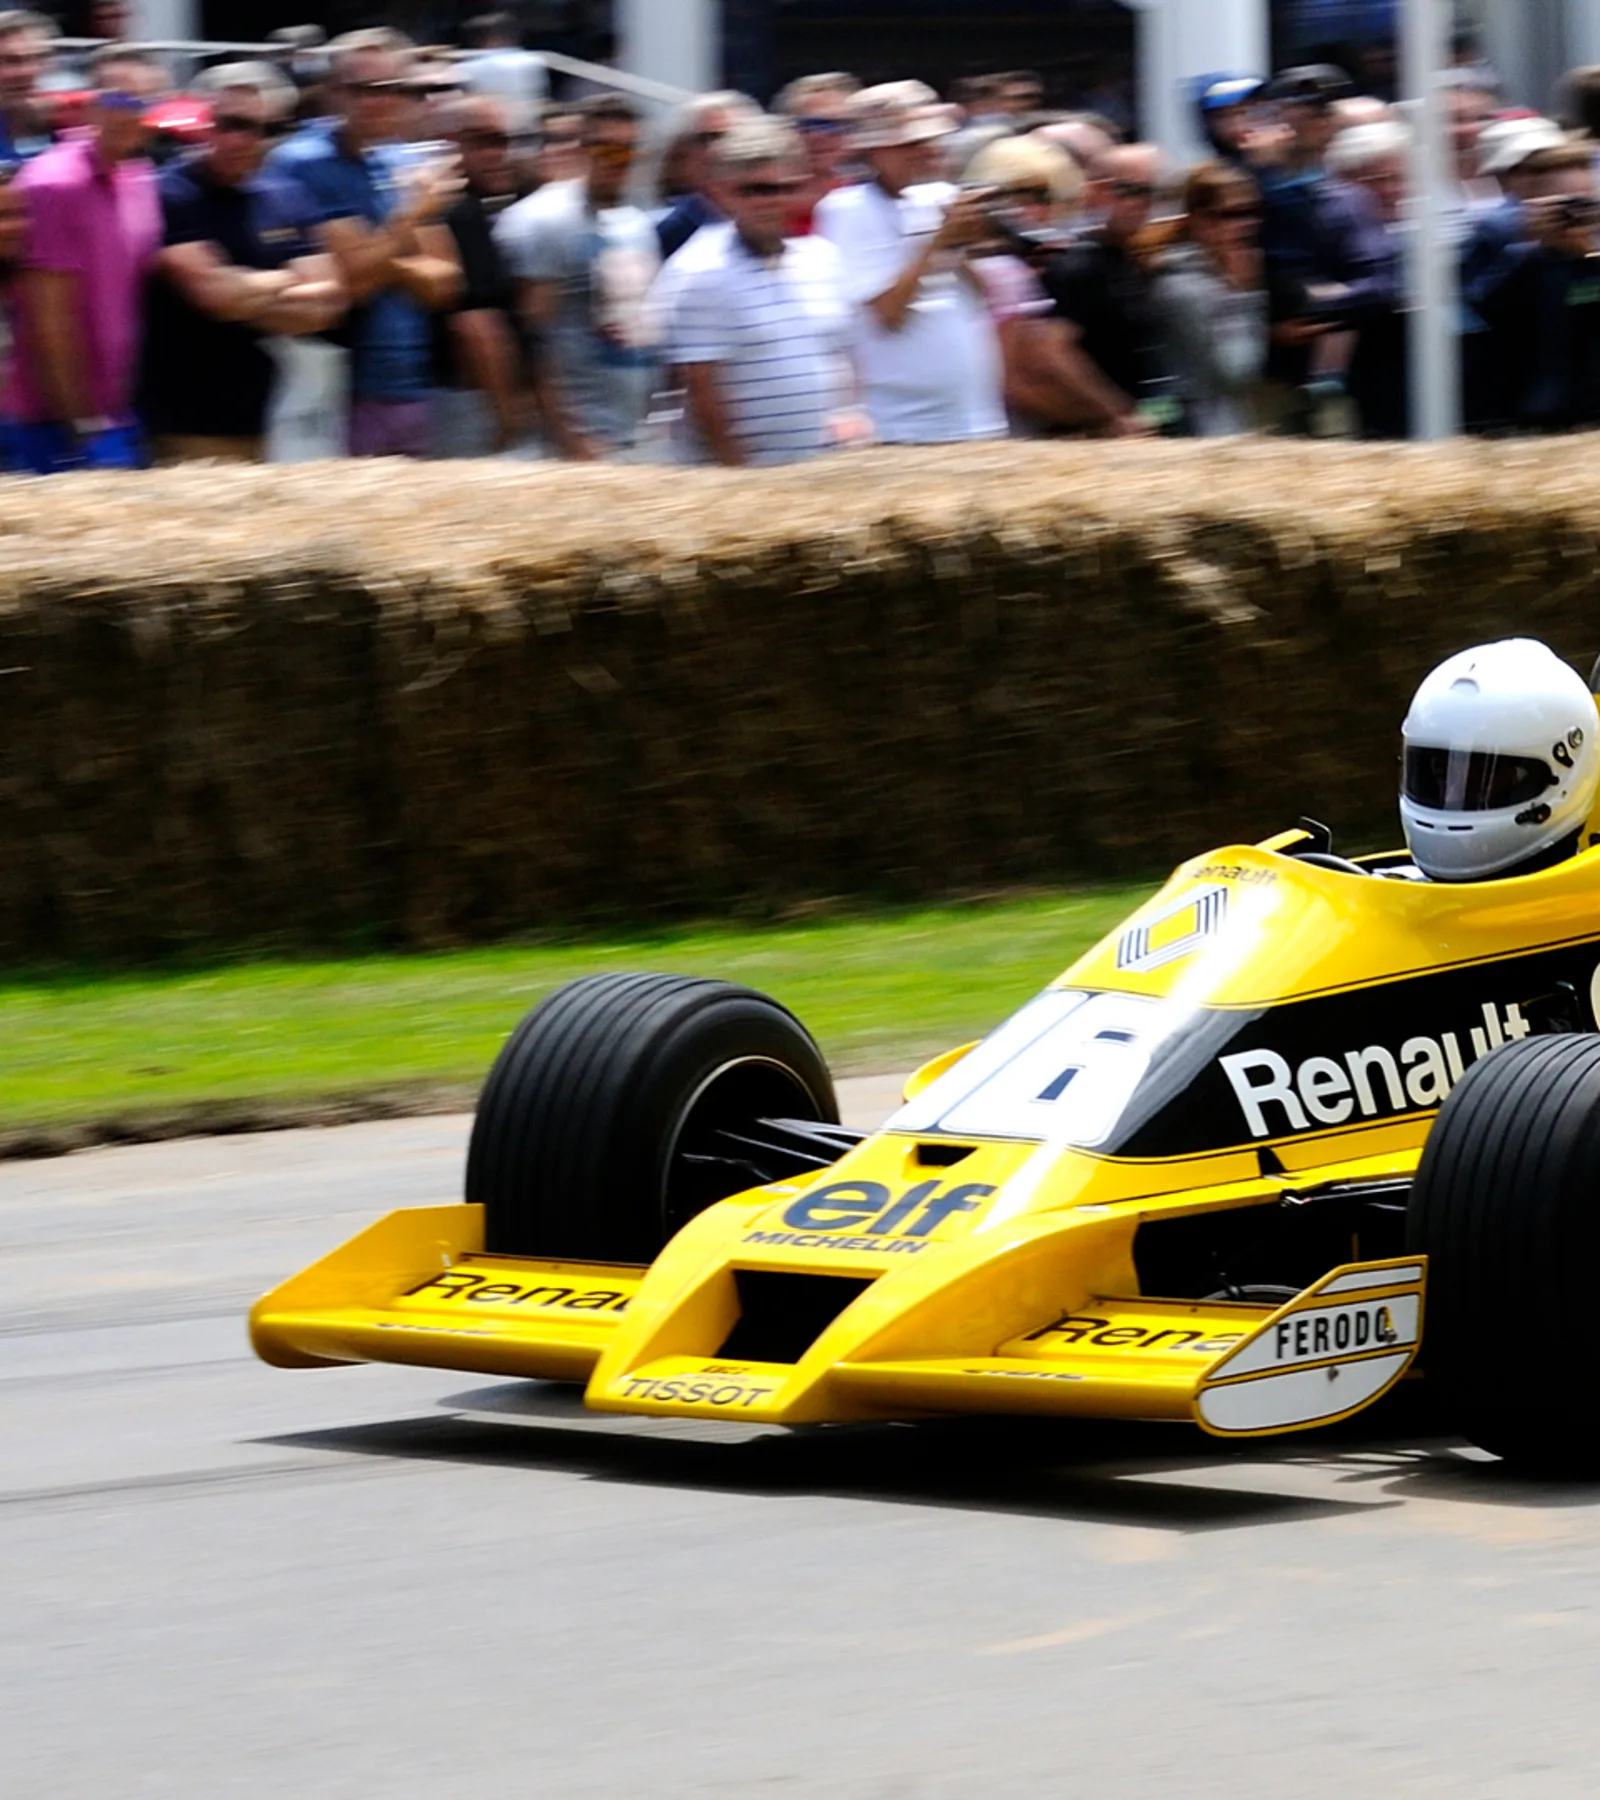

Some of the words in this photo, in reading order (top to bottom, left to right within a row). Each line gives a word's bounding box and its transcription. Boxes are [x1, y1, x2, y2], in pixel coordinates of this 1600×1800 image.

[782, 1179, 998, 1238] elf
[742, 1231, 930, 1254] MICHELIN
[623, 1378, 772, 1407] TISSOT
